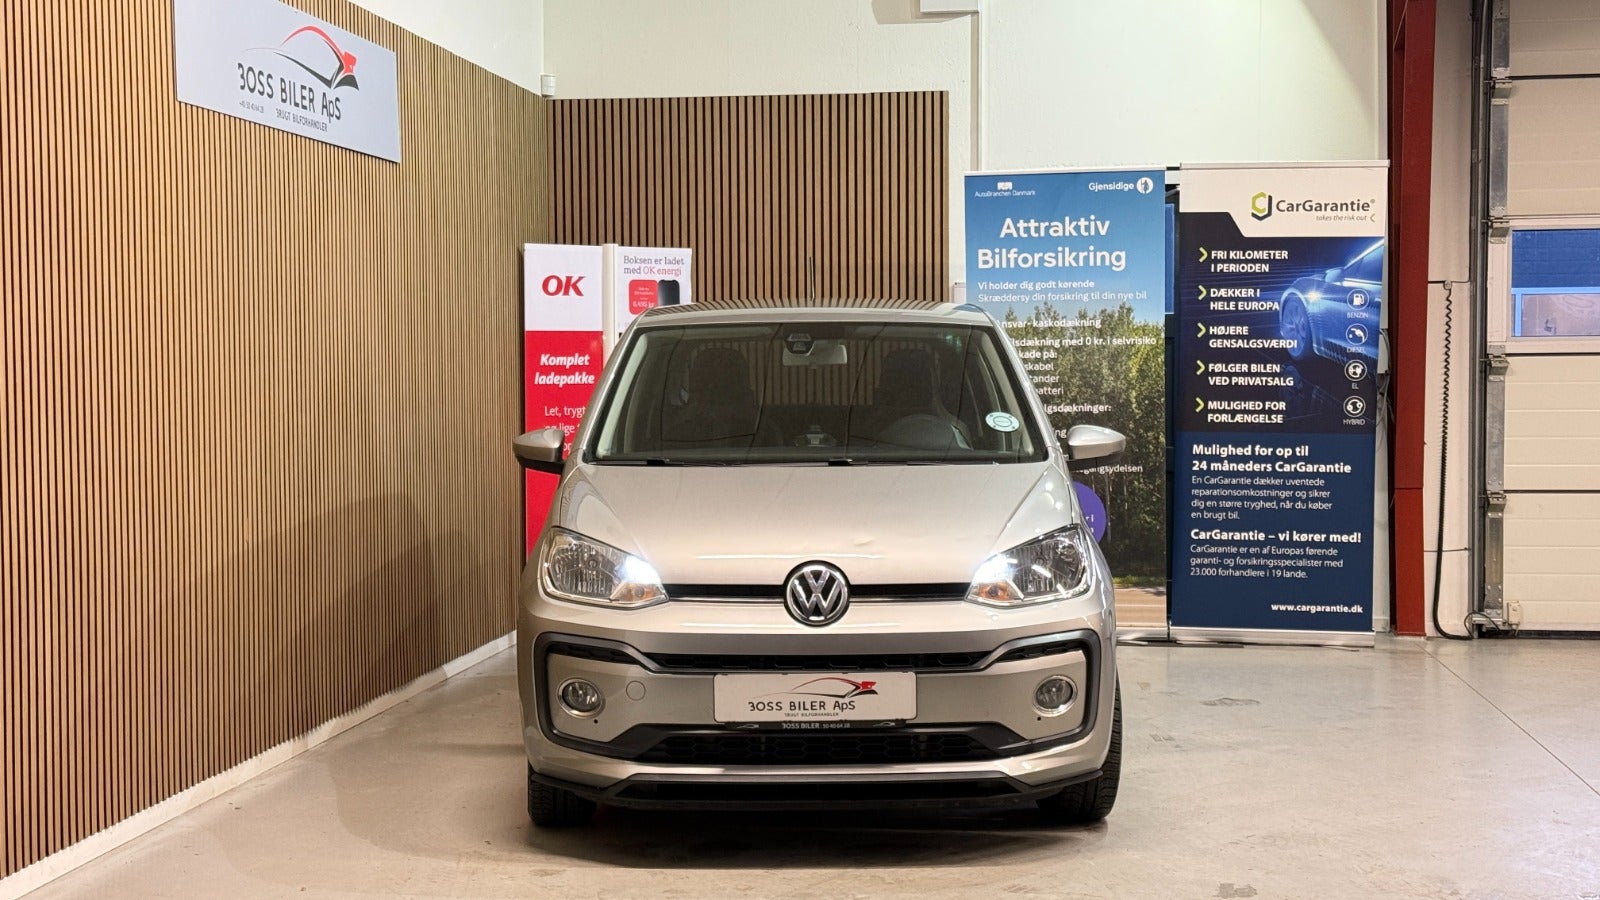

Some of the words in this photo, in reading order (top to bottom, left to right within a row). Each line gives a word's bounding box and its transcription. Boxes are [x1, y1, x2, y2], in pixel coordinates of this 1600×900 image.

[280, 77, 316, 114] BILER
[321, 91, 342, 124] ApS
[1088, 182, 1134, 192] Gjensidige
[1000, 215, 1110, 238] Attraktiv
[624, 255, 652, 265] Boksen
[664, 256, 685, 265] ladet
[978, 246, 1126, 271] Bilforsikring
[1211, 250, 1227, 259] FRI
[1230, 250, 1288, 260] KILOMETER
[643, 266, 656, 274] OK
[657, 267, 682, 277] energi
[1211, 264, 1214, 272] I
[1217, 264, 1269, 272] PERIODEN
[542, 275, 586, 297] OK
[978, 282, 987, 290] Vi
[989, 281, 1017, 290] holder
[1019, 280, 1033, 291] dig
[1035, 280, 1056, 291] godt
[1058, 280, 1095, 288] kørende
[978, 293, 1030, 304] Skræddersy
[1032, 293, 1046, 301] din
[1048, 292, 1088, 302] forsikring
[1089, 292, 1100, 300] til
[1102, 292, 1115, 300] din
[1118, 293, 1134, 302] nye
[1136, 291, 1148, 300] bil
[1210, 288, 1255, 297] DÆKKER
[1257, 289, 1260, 297] I
[1210, 302, 1236, 310] HELE
[1238, 302, 1280, 311] EUROPA
[1033, 317, 1101, 328] kaskodækning
[1209, 326, 1249, 335] HØJERE
[1010, 337, 1060, 348] lsdækning
[1062, 336, 1083, 345] med
[1209, 339, 1297, 348] GENSALGSVÆRDI
[1018, 350, 1041, 359] kade
[1043, 349, 1058, 360] på:
[540, 353, 590, 369] Komplet
[1024, 362, 1054, 371] skabel
[1208, 363, 1248, 373] FØLGER
[1251, 364, 1280, 372] BILEN
[535, 372, 595, 388] ladepakke
[1208, 377, 1229, 386] VED
[1232, 377, 1294, 386] PRIVATSALG
[1044, 404, 1112, 414] lgsdækninger:
[1207, 401, 1263, 410] MULIGHED
[1265, 402, 1286, 410] FOR
[544, 406, 561, 417] Let,
[564, 406, 586, 418] trygt
[1207, 414, 1284, 423] FORLÆNGELSE
[1192, 444, 1252, 457] Mulighed
[1255, 445, 1274, 456] for
[1276, 447, 1293, 458] op
[1295, 446, 1309, 456] til
[1192, 460, 1208, 471] 24
[1210, 460, 1272, 472] måneders
[1275, 461, 1352, 473] CarGarantie
[1204, 476, 1252, 485] CarGarantie
[1253, 477, 1283, 486] dækker
[1285, 478, 1325, 486] uventede
[1191, 489, 1293, 498] reparationsomkostninger
[1295, 491, 1306, 499] og
[1308, 490, 1330, 498] sikrer
[1191, 500, 1204, 509] dig
[1244, 500, 1278, 510] tryghed,
[1280, 500, 1293, 509] når
[1295, 501, 1306, 509] du
[1308, 501, 1332, 509] køber
[1204, 511, 1226, 520] brugt
[1228, 511, 1240, 520] bil.
[1191, 529, 1265, 541] CarGarantie
[1278, 531, 1289, 541] vi
[1292, 531, 1326, 542] kører
[1329, 532, 1361, 542] med!
[1190, 545, 1238, 554] CarGarantie
[1262, 546, 1270, 554] af
[1272, 546, 1304, 556] Europas
[1306, 547, 1338, 556] førende
[1190, 557, 1222, 566] garanti-
[1236, 557, 1323, 568] forsikringsspecialister
[1324, 559, 1343, 567] med
[1218, 568, 1265, 577] forhandlere
[1283, 570, 1308, 578] lande.
[1271, 603, 1363, 613] www.cargarantie.dk
[789, 701, 826, 711] BILER
[833, 701, 856, 712] ApS
